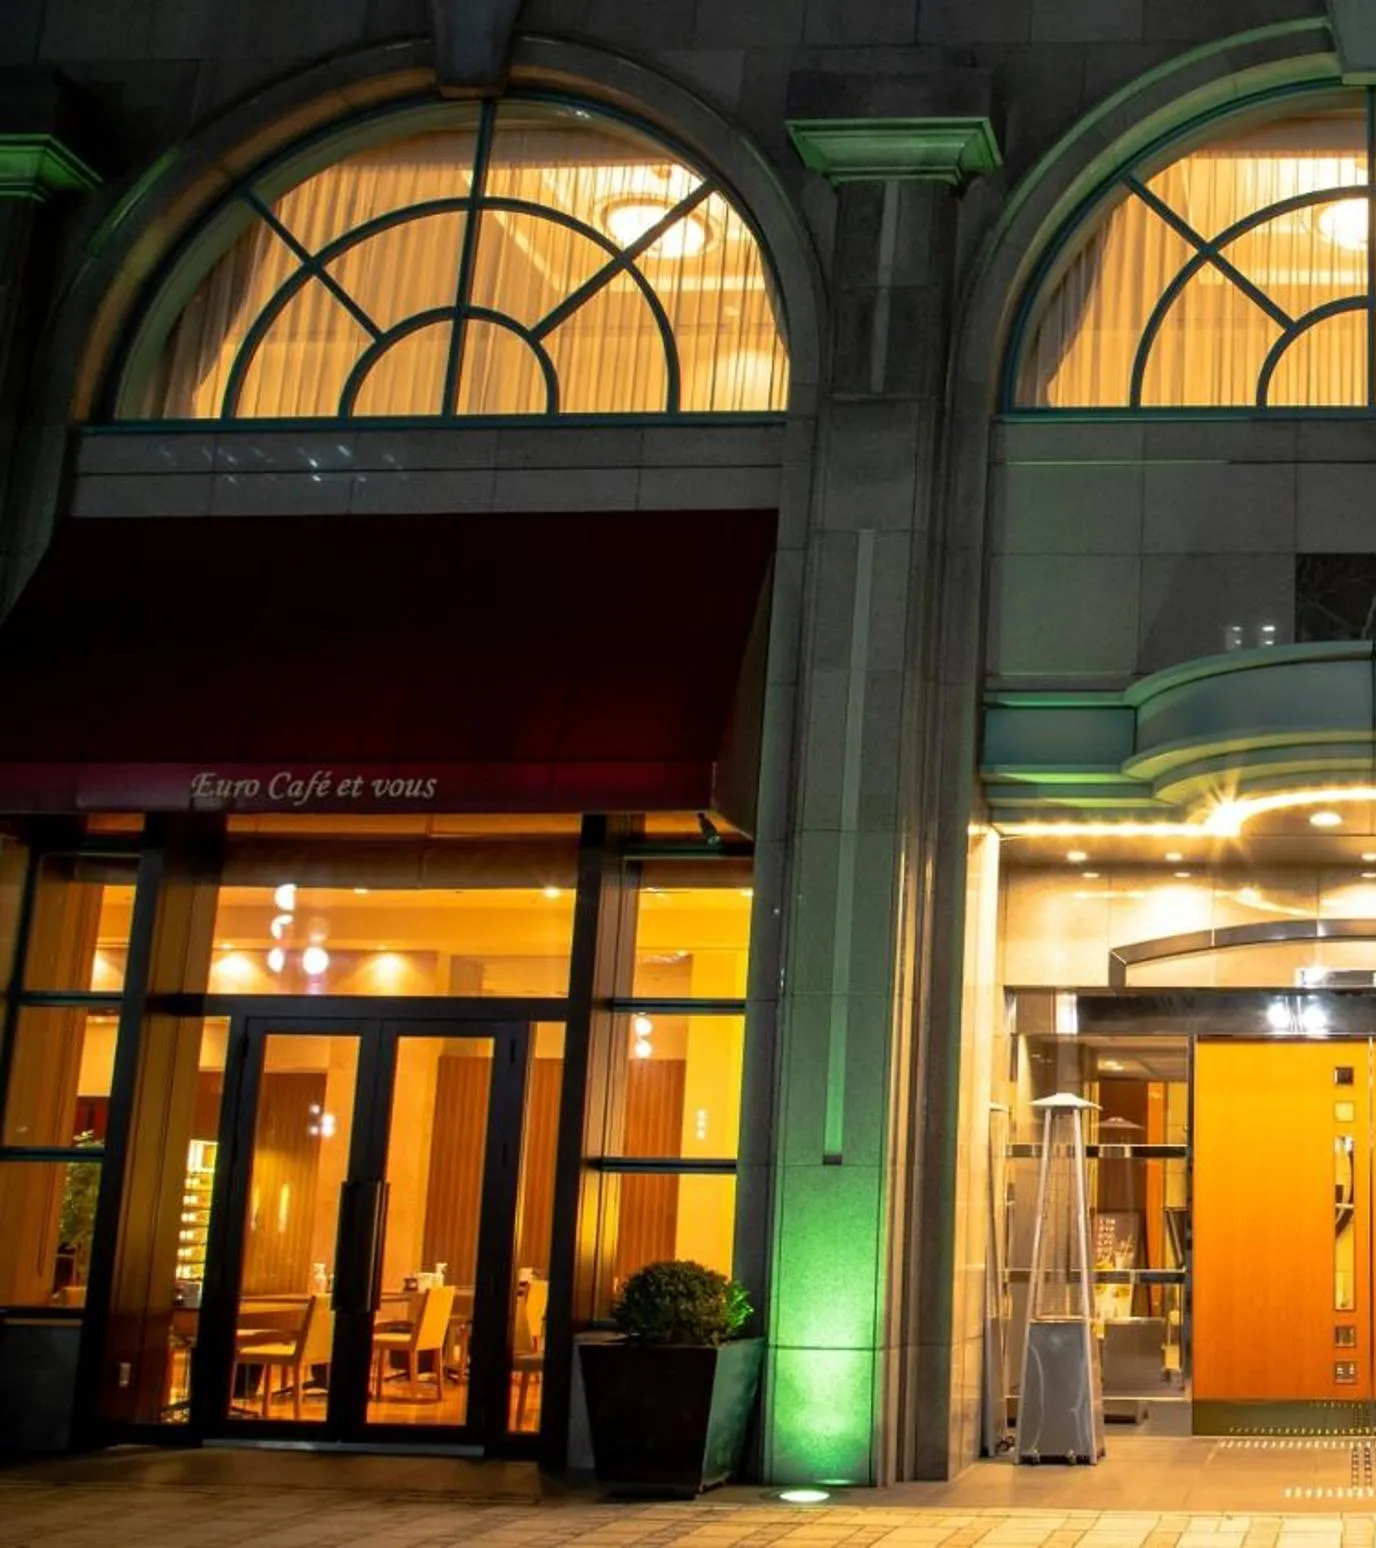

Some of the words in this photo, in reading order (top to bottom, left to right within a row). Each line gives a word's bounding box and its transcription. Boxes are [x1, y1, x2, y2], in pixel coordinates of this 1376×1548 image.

[192, 772, 261, 798] Euro
[268, 770, 333, 806] Café
[336, 776, 364, 798] et
[371, 778, 438, 798] vous
